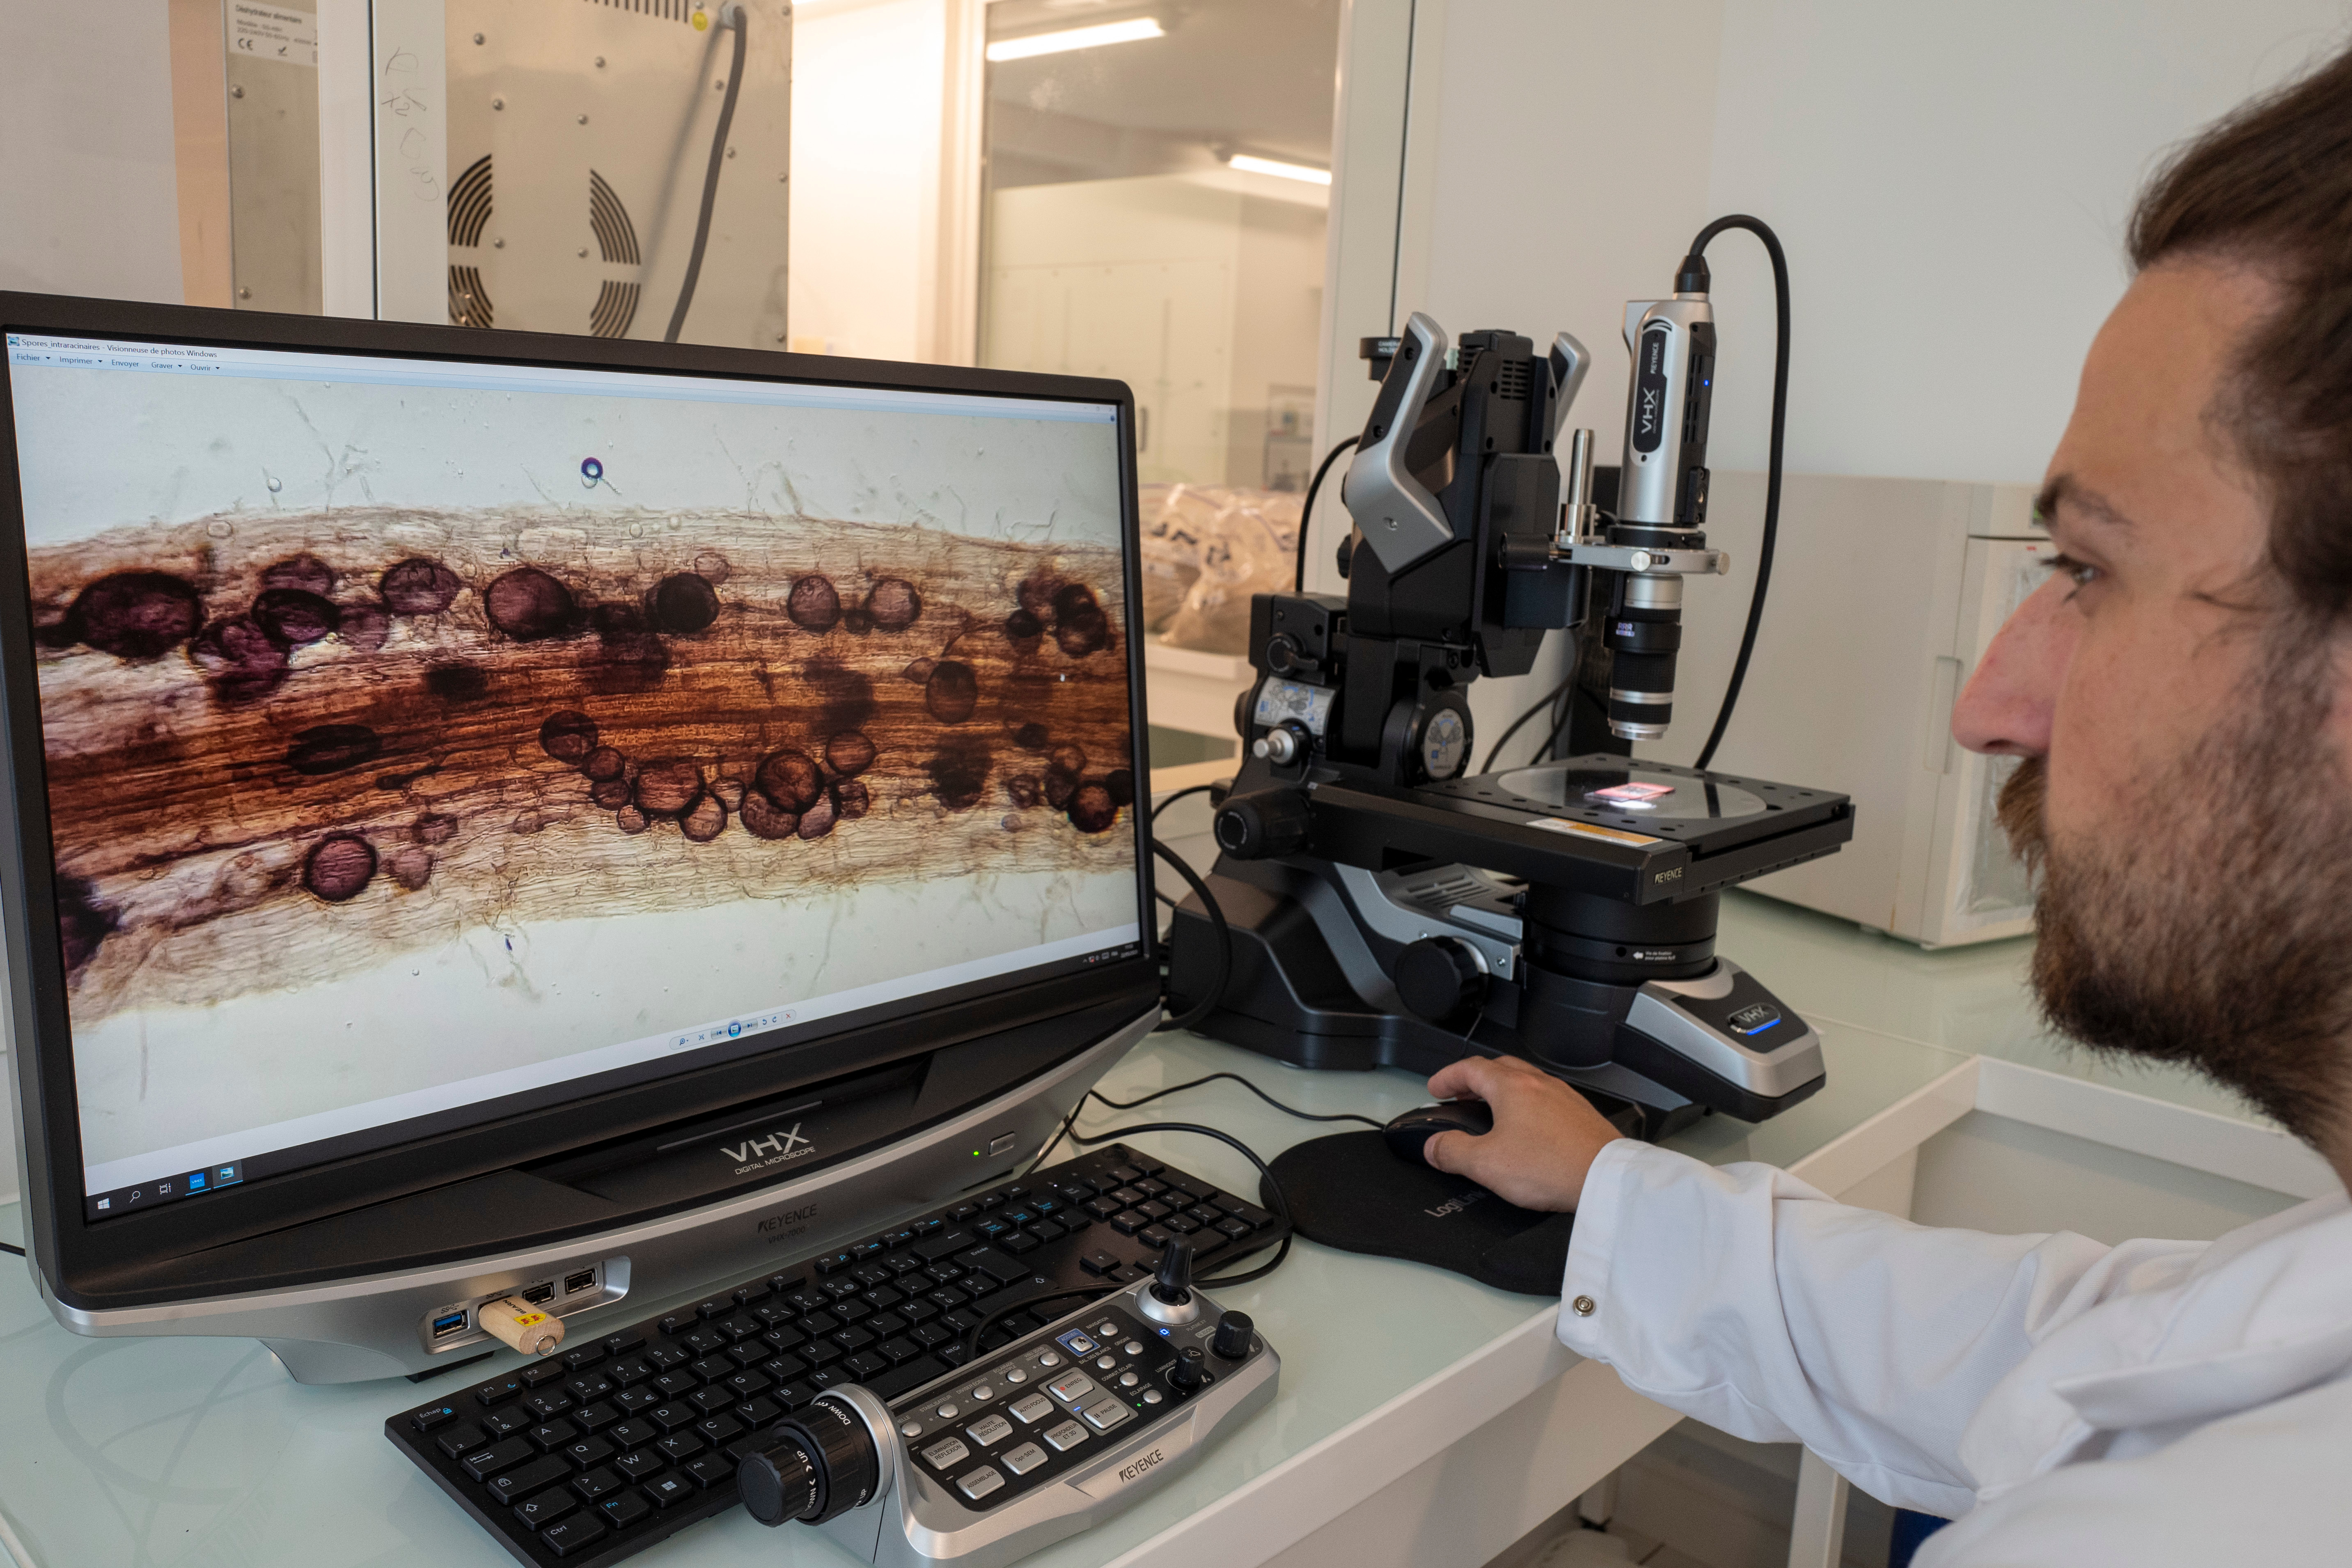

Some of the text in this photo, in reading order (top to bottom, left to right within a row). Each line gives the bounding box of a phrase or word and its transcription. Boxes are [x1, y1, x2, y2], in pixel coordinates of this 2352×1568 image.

[22, 339, 100, 350] Spores_intraracinaires
[107, 344, 148, 353] Visionneuse
[112, 360, 139, 368] Envoyer
[1641, 387, 1657, 434] VHX
[1655, 867, 1683, 885] KEYENCE
[1738, 1006, 1769, 1023] VHX
[720, 1122, 810, 1162] VHX
[735, 1146, 816, 1175] DIGITAL MICROSCOPE
[758, 1204, 818, 1233] KEYENCE
[503, 1299, 527, 1314] BÉARN
[1086, 1316, 1109, 1329] NAVIGATION
[1061, 1331, 1078, 1341] ACCUEIL
[1114, 1336, 1131, 1346] ORIGINE
[946, 1346, 960, 1354] AltGr
[1095, 1346, 1111, 1357] BLANCS
[993, 1362, 1014, 1373] ÉCLAIRAGE
[998, 1365, 1017, 1375] MULTIPLE
[1155, 1359, 1177, 1373] LUMINOSITÉ
[1101, 1371, 1120, 1381] COMMUT.
[956, 1377, 988, 1394] DIVISER ÉCRAN
[1065, 1378, 1083, 1389] ENREG.
[1130, 1382, 1152, 1396] ÉCLAIRAGE
[919, 1394, 953, 1412] STABILISATEUR
[1019, 1397, 1046, 1413] AUTO FOCUS
[1100, 1404, 1118, 1415] PAUSE
[420, 1409, 441, 1418] Échap
[828, 1405, 851, 1426] DOWN
[978, 1421, 1007, 1438] RÉSOLUTION
[979, 1420, 997, 1430] HAUTE
[1050, 1422, 1078, 1440] PROFONDEUR
[928, 1440, 959, 1457] ÉLIMINATION
[934, 1444, 963, 1461] RÉFLEXION
[624, 1455, 639, 1464] W
[797, 1450, 809, 1463] UP
[1015, 1449, 1036, 1463] Opt-SEM
[1119, 1449, 1164, 1483] KEYENCE
[967, 1470, 997, 1489] ASSEMBLAGE
[805, 1488, 817, 1512] DOWN
[551, 1525, 567, 1534] Ctrl
